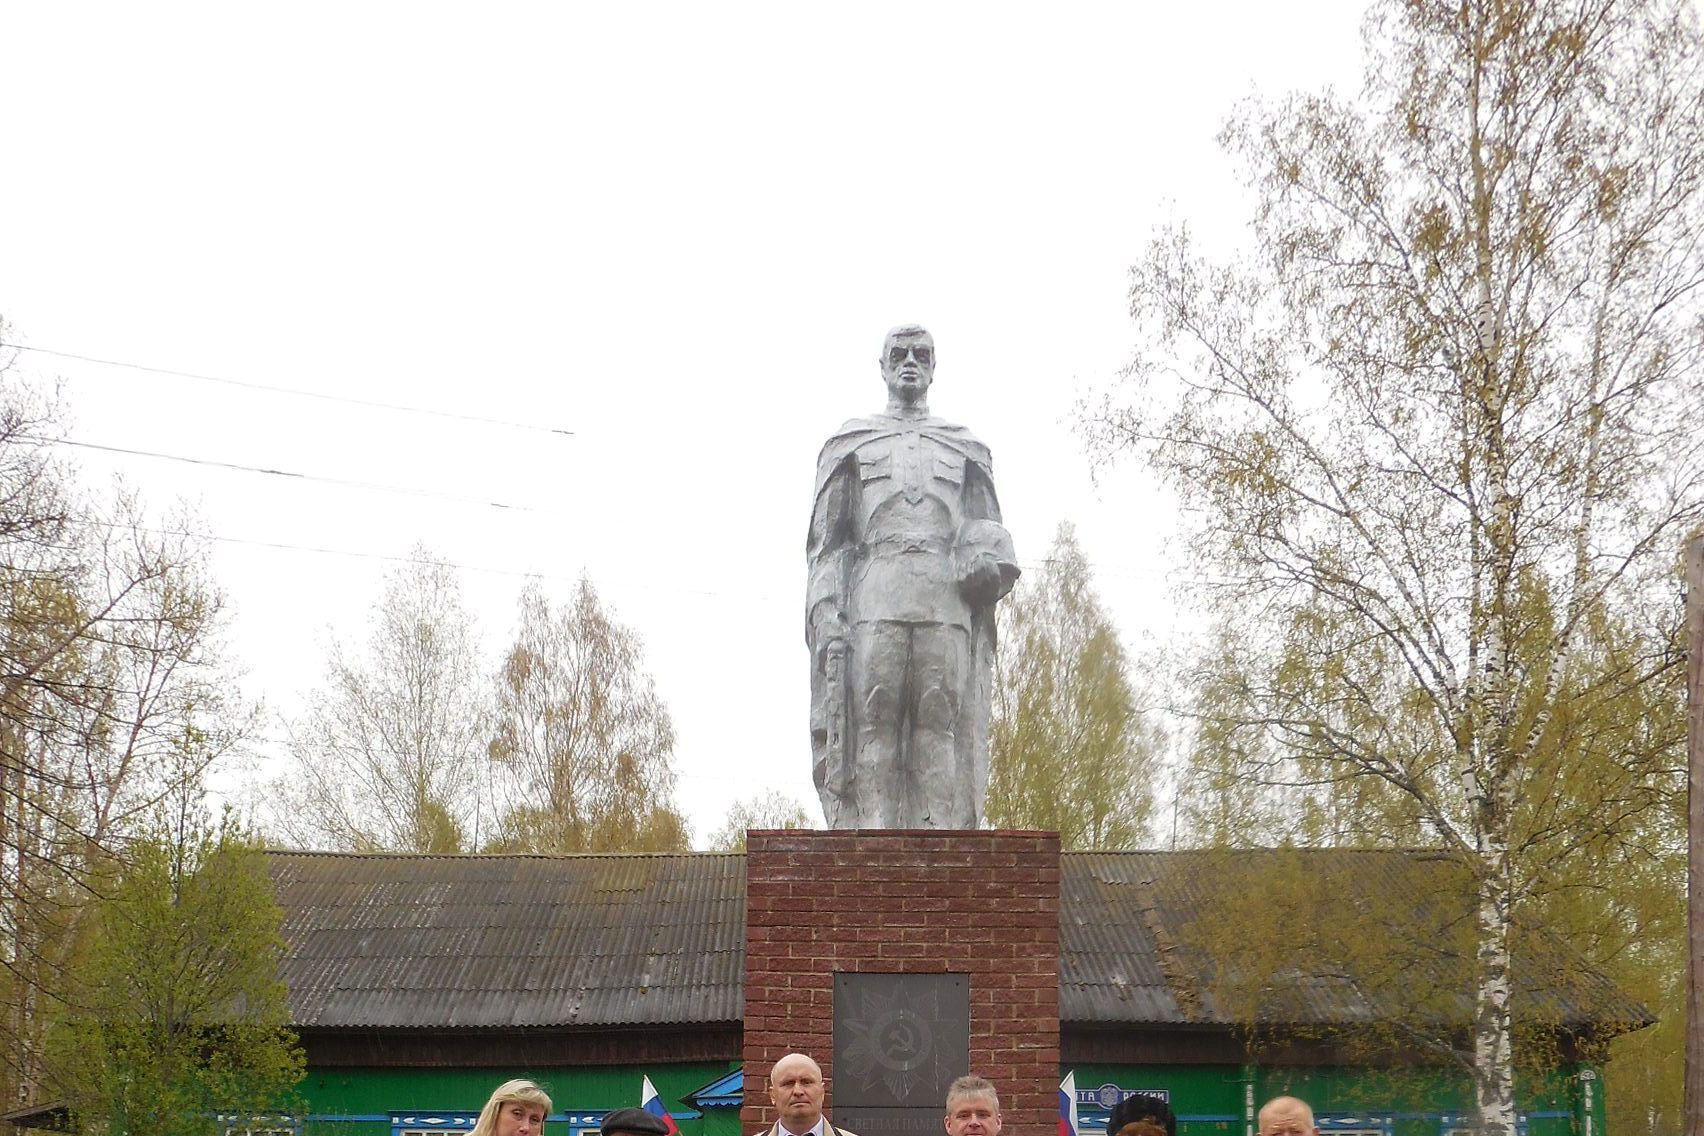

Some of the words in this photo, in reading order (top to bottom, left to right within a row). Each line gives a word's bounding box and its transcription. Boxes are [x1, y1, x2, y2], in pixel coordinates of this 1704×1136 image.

[1123, 1091, 1165, 1101] РИИ
[848, 1118, 900, 1130] СВЕТЛАЯ
[902, 1118, 944, 1130] ПАМЯТ
